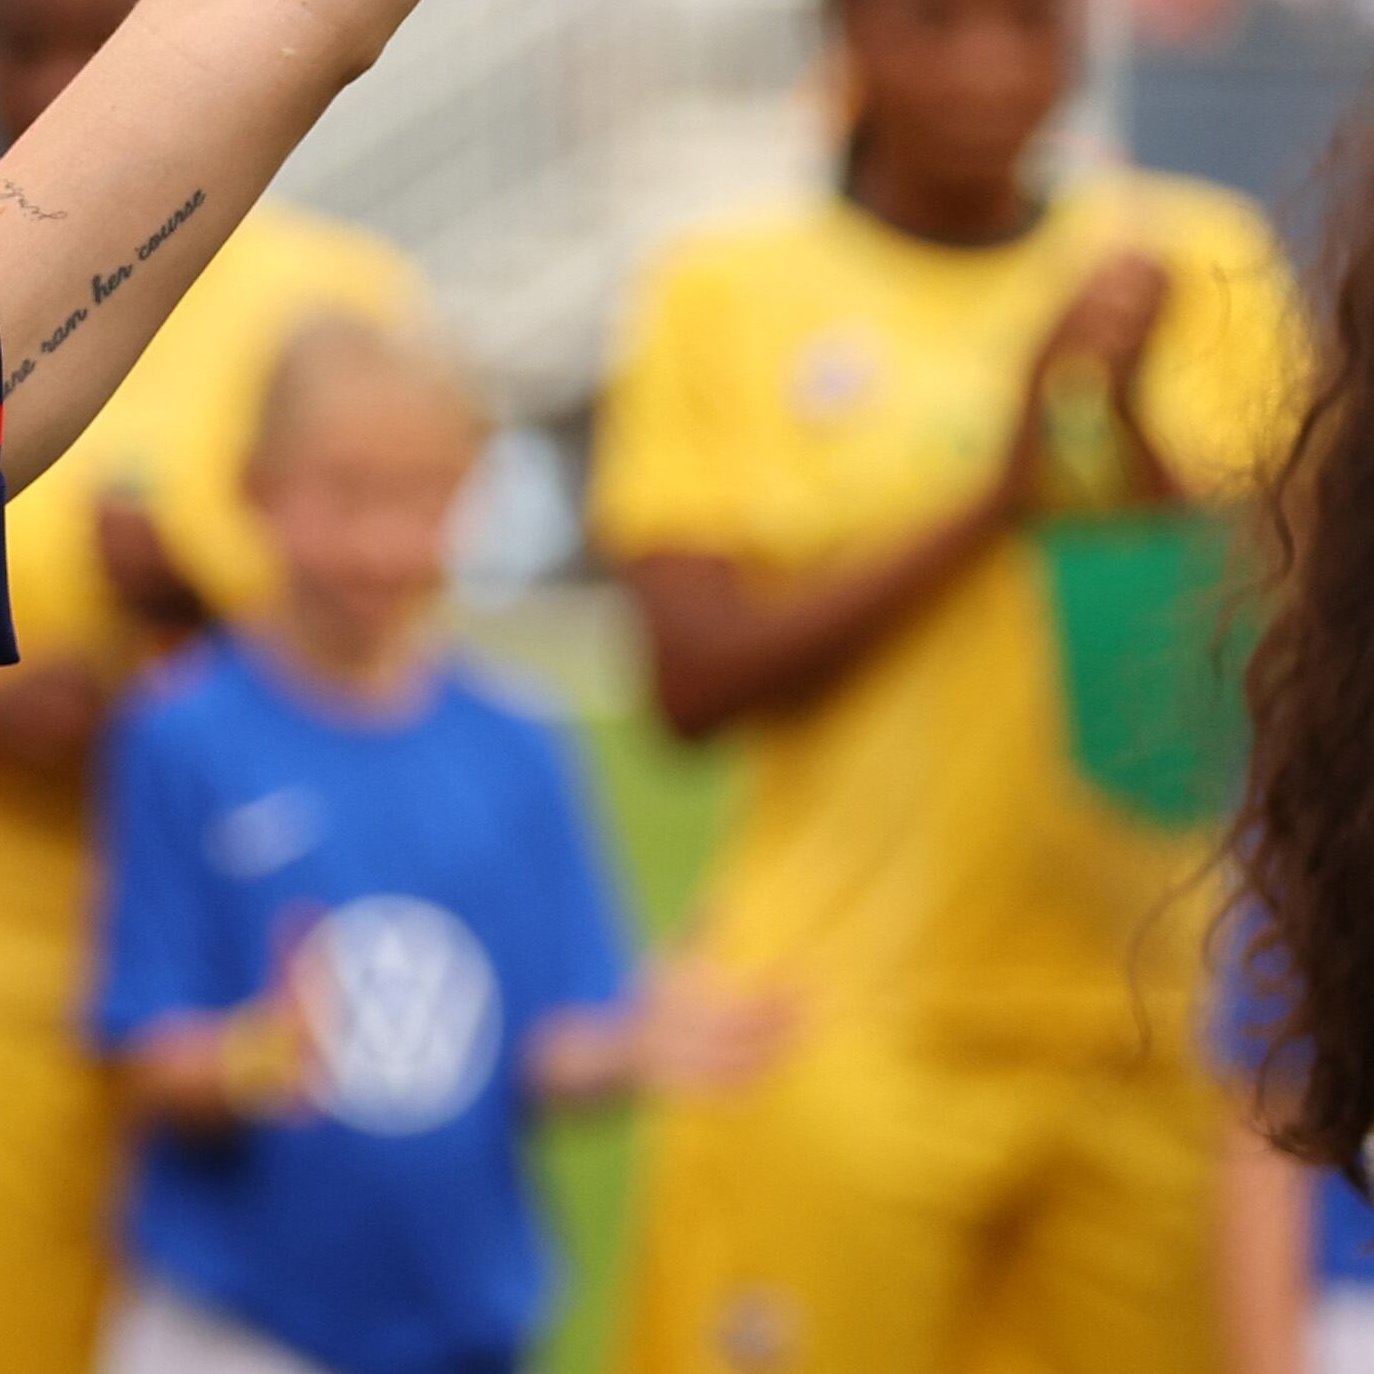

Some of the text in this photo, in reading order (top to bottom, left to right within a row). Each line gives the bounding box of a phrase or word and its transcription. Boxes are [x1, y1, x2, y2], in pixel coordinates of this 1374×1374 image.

[41, 308, 88, 354] ran
[91, 264, 133, 305] her
[136, 189, 206, 261] course
